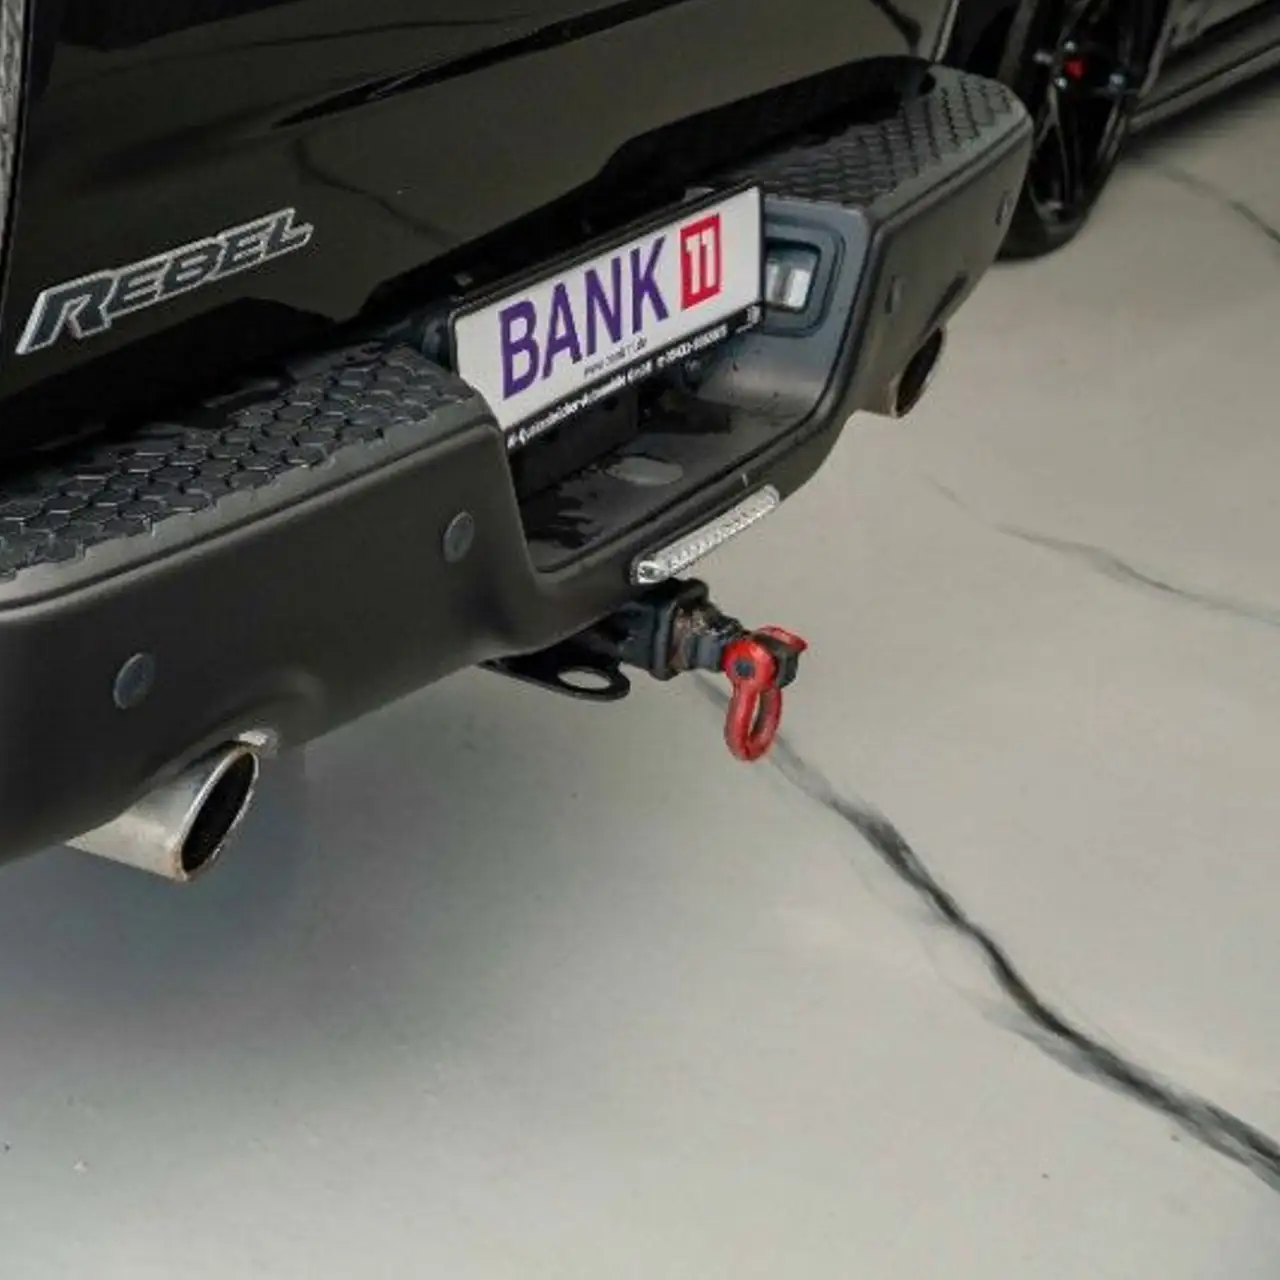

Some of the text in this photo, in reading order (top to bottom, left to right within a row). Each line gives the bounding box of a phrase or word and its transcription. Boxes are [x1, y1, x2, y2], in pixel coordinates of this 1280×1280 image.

[15, 207, 314, 355] REBEL
[498, 236, 669, 400] BANK
[683, 222, 719, 306] 11
